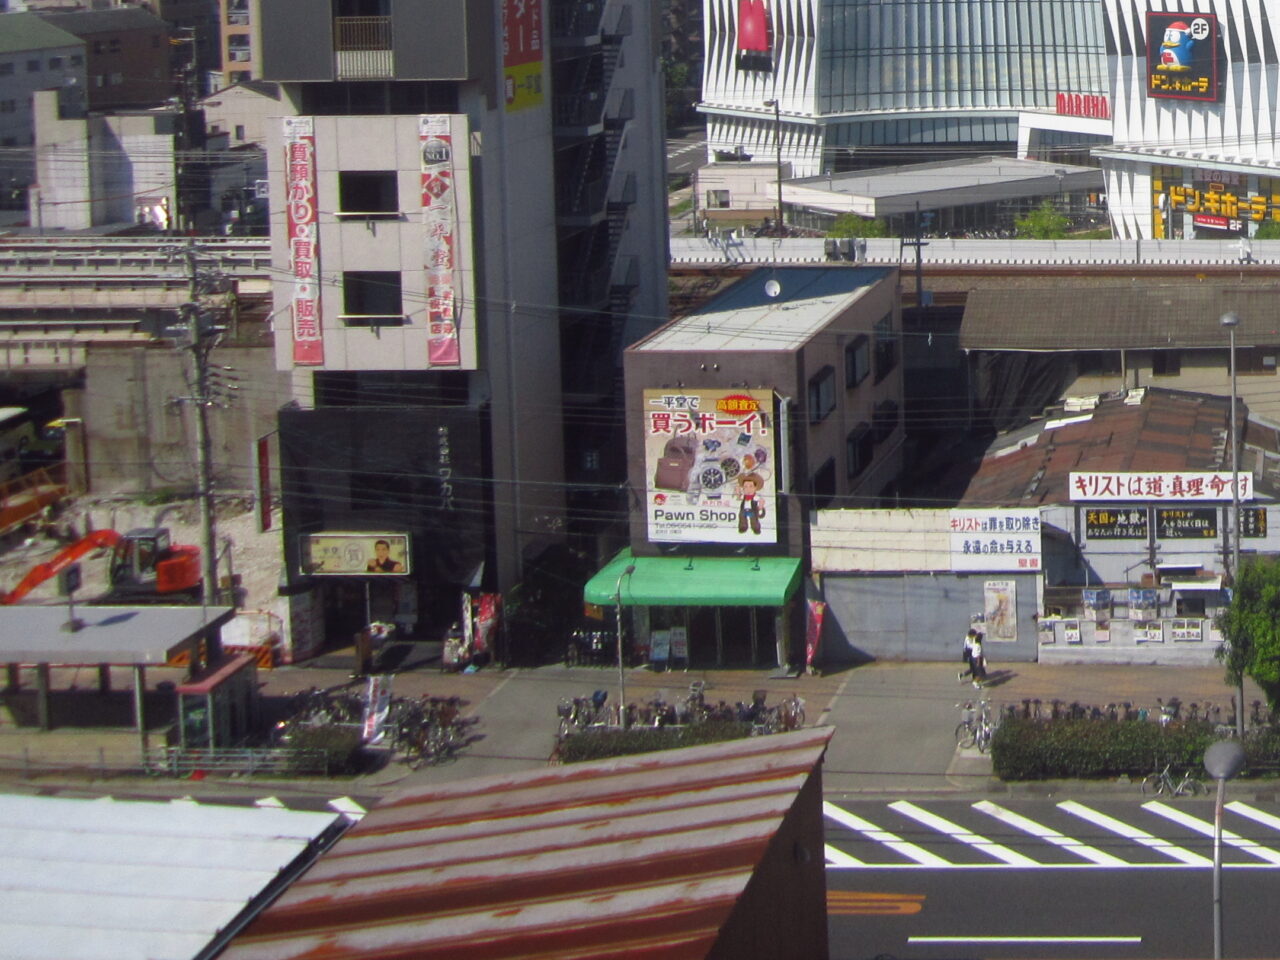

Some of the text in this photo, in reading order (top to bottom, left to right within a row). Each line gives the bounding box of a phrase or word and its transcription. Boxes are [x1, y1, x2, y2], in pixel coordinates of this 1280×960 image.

[1192, 22, 1208, 36] 2F
[1056, 91, 1111, 120] MARUHA
[1229, 220, 1243, 231] 2F
[654, 509, 736, 522] Pawn Shop
[950, 516, 1040, 531] キリストは罪を取り除き
[963, 539, 1033, 554] 永遠の命を与える
